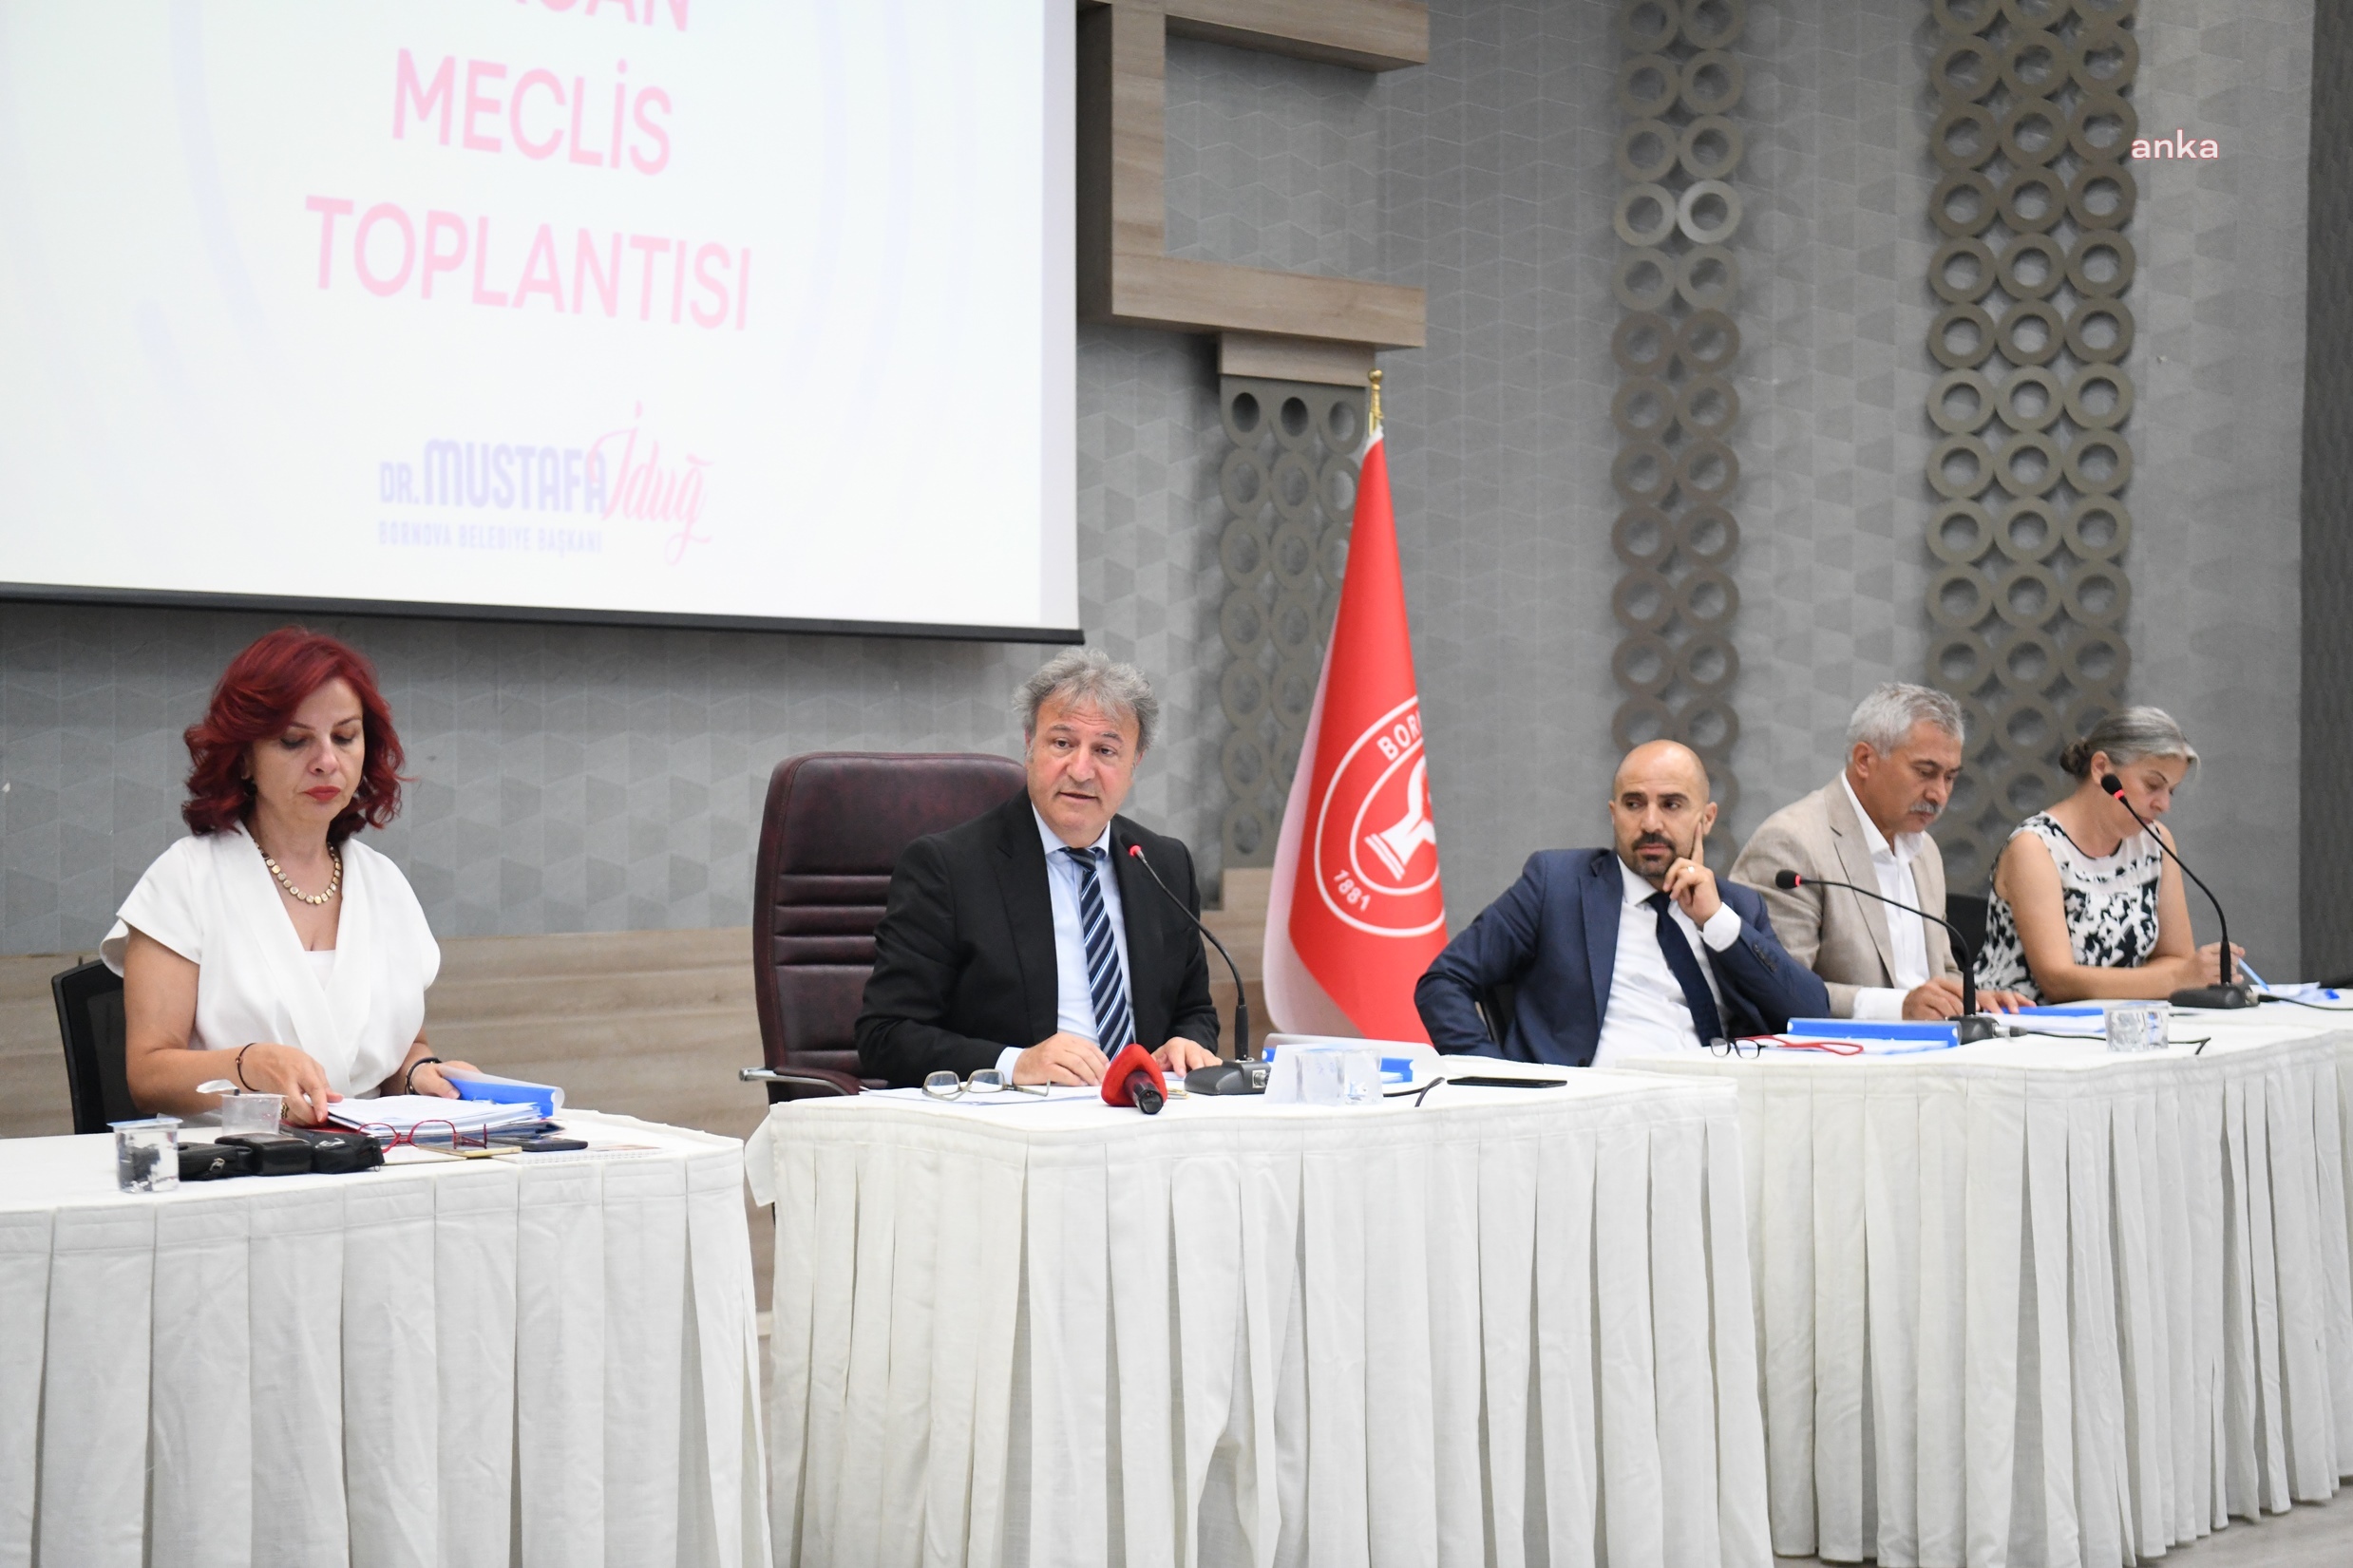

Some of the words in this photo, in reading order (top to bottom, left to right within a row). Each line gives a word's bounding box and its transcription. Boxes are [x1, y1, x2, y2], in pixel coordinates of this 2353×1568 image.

[392, 47, 673, 176] MECLİS
[305, 195, 751, 331] TOPLANTISI
[379, 462, 420, 505] DR.
[424, 438, 608, 514] MUSTAFA
[378, 520, 452, 546] BORNOVA
[458, 524, 531, 551] BELEDİYE
[538, 527, 603, 558] BAŞKANI
[1376, 710, 1422, 761] BOR
[1333, 869, 1371, 912] 1881
